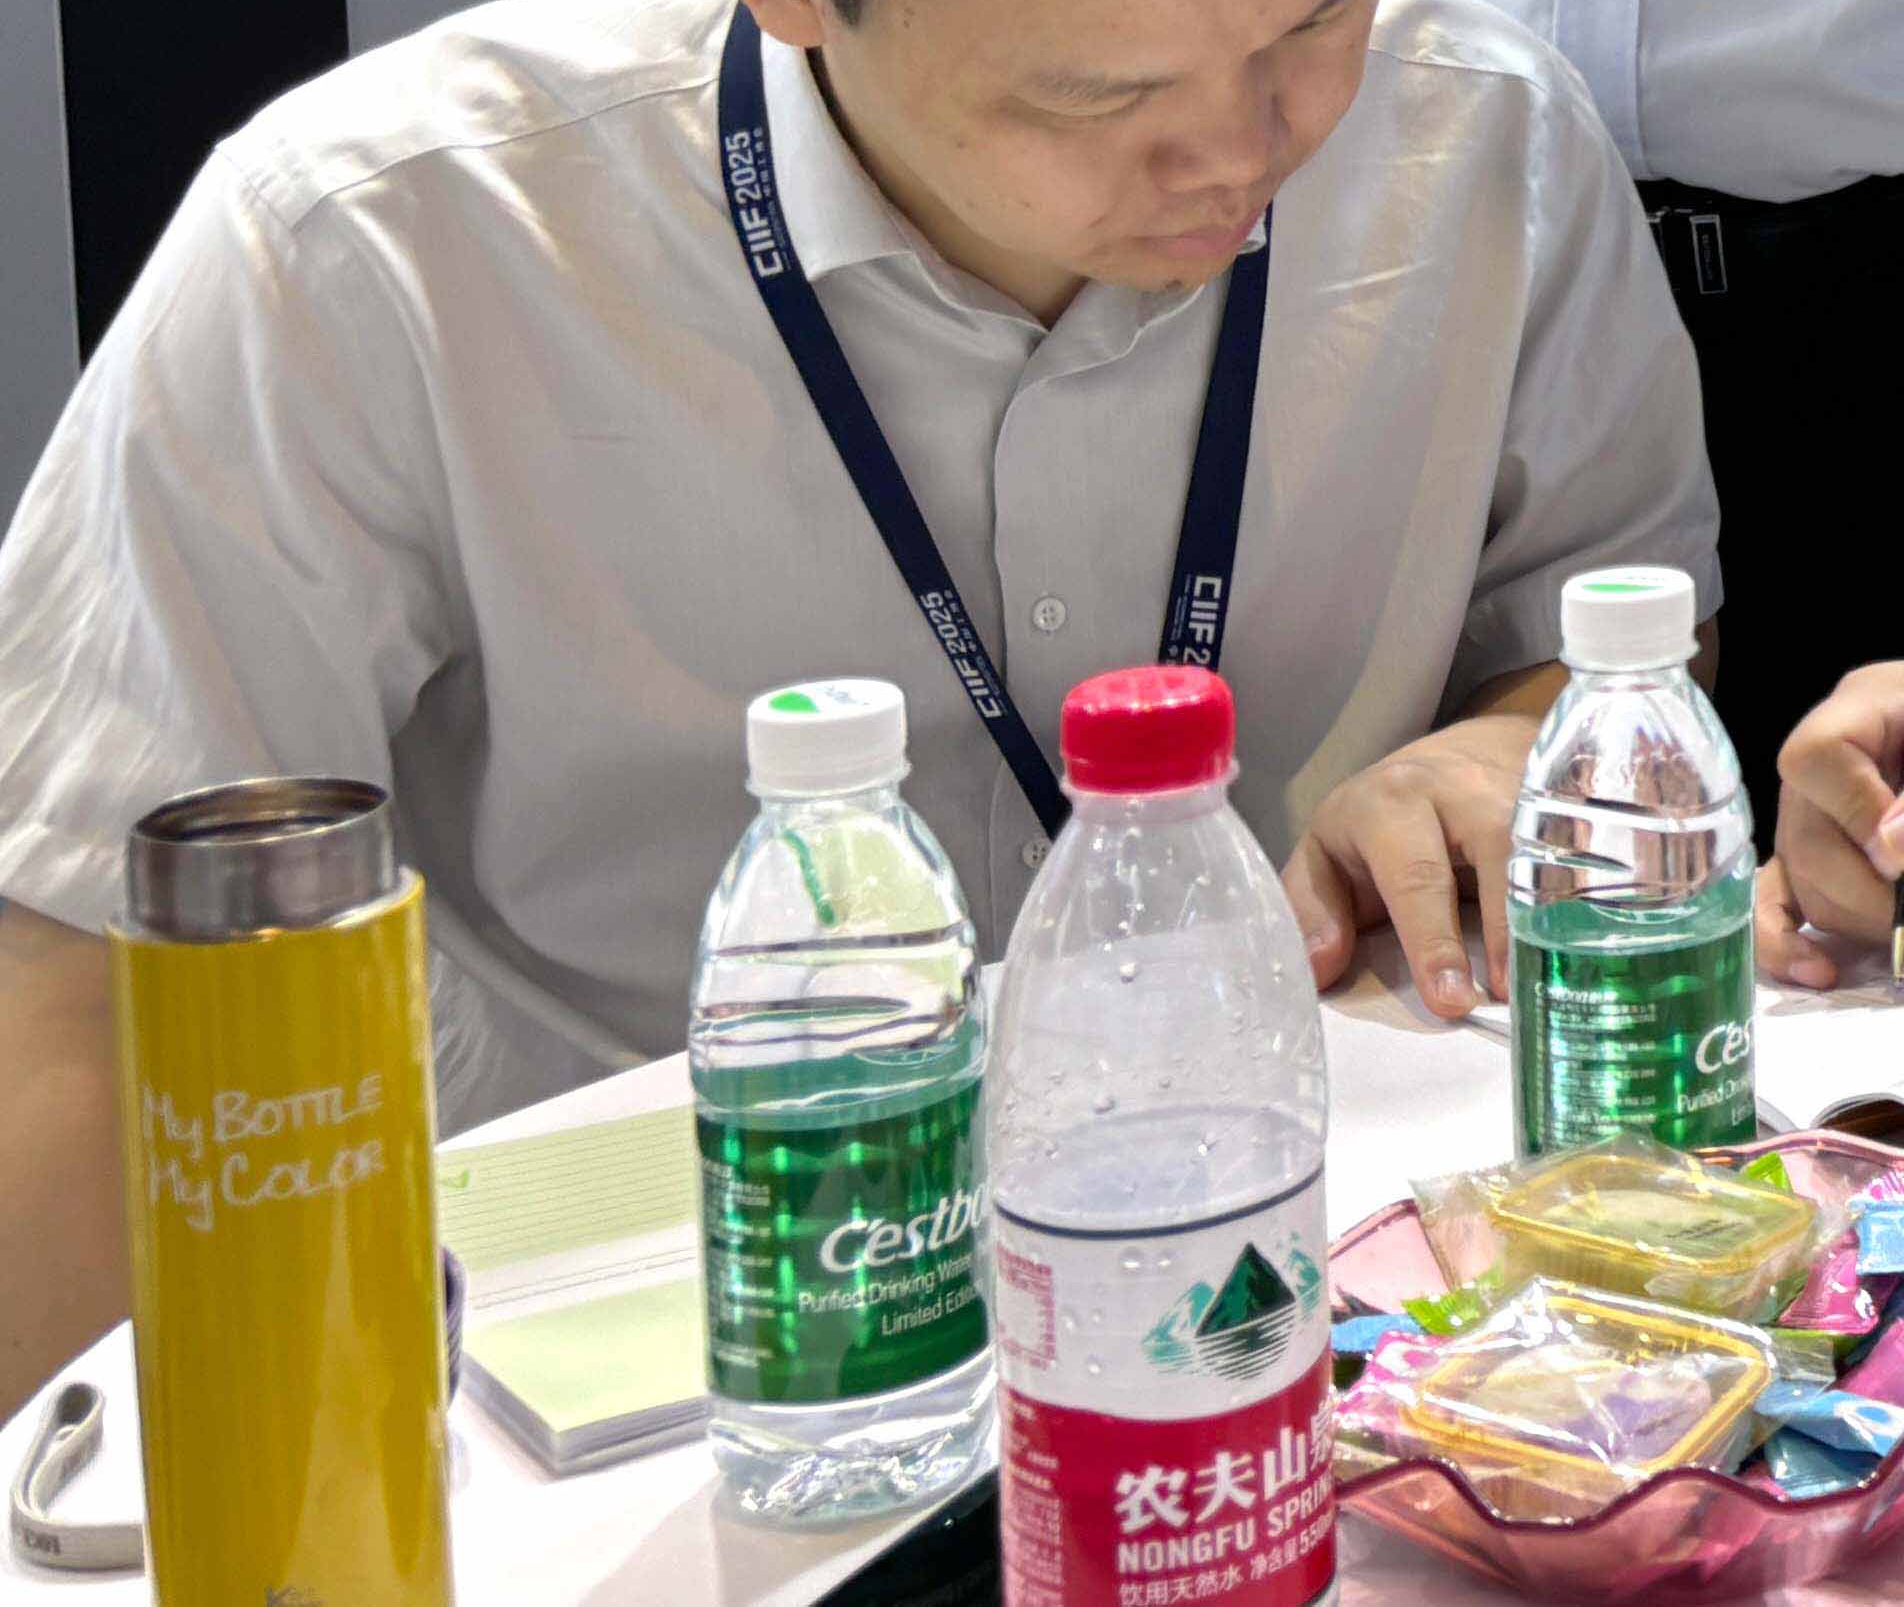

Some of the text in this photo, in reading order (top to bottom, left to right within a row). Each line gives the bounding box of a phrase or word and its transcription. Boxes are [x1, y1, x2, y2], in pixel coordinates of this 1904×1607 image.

[725, 130, 784, 278] CIIF 2025
[1188, 576, 1222, 645] CIIF
[920, 592, 1002, 718] CIIF 2025
[143, 1081, 203, 1164] My
[148, 1150, 215, 1233] My
[881, 1297, 943, 1337] Limited
[1117, 1516, 1257, 1575] NONGFU
